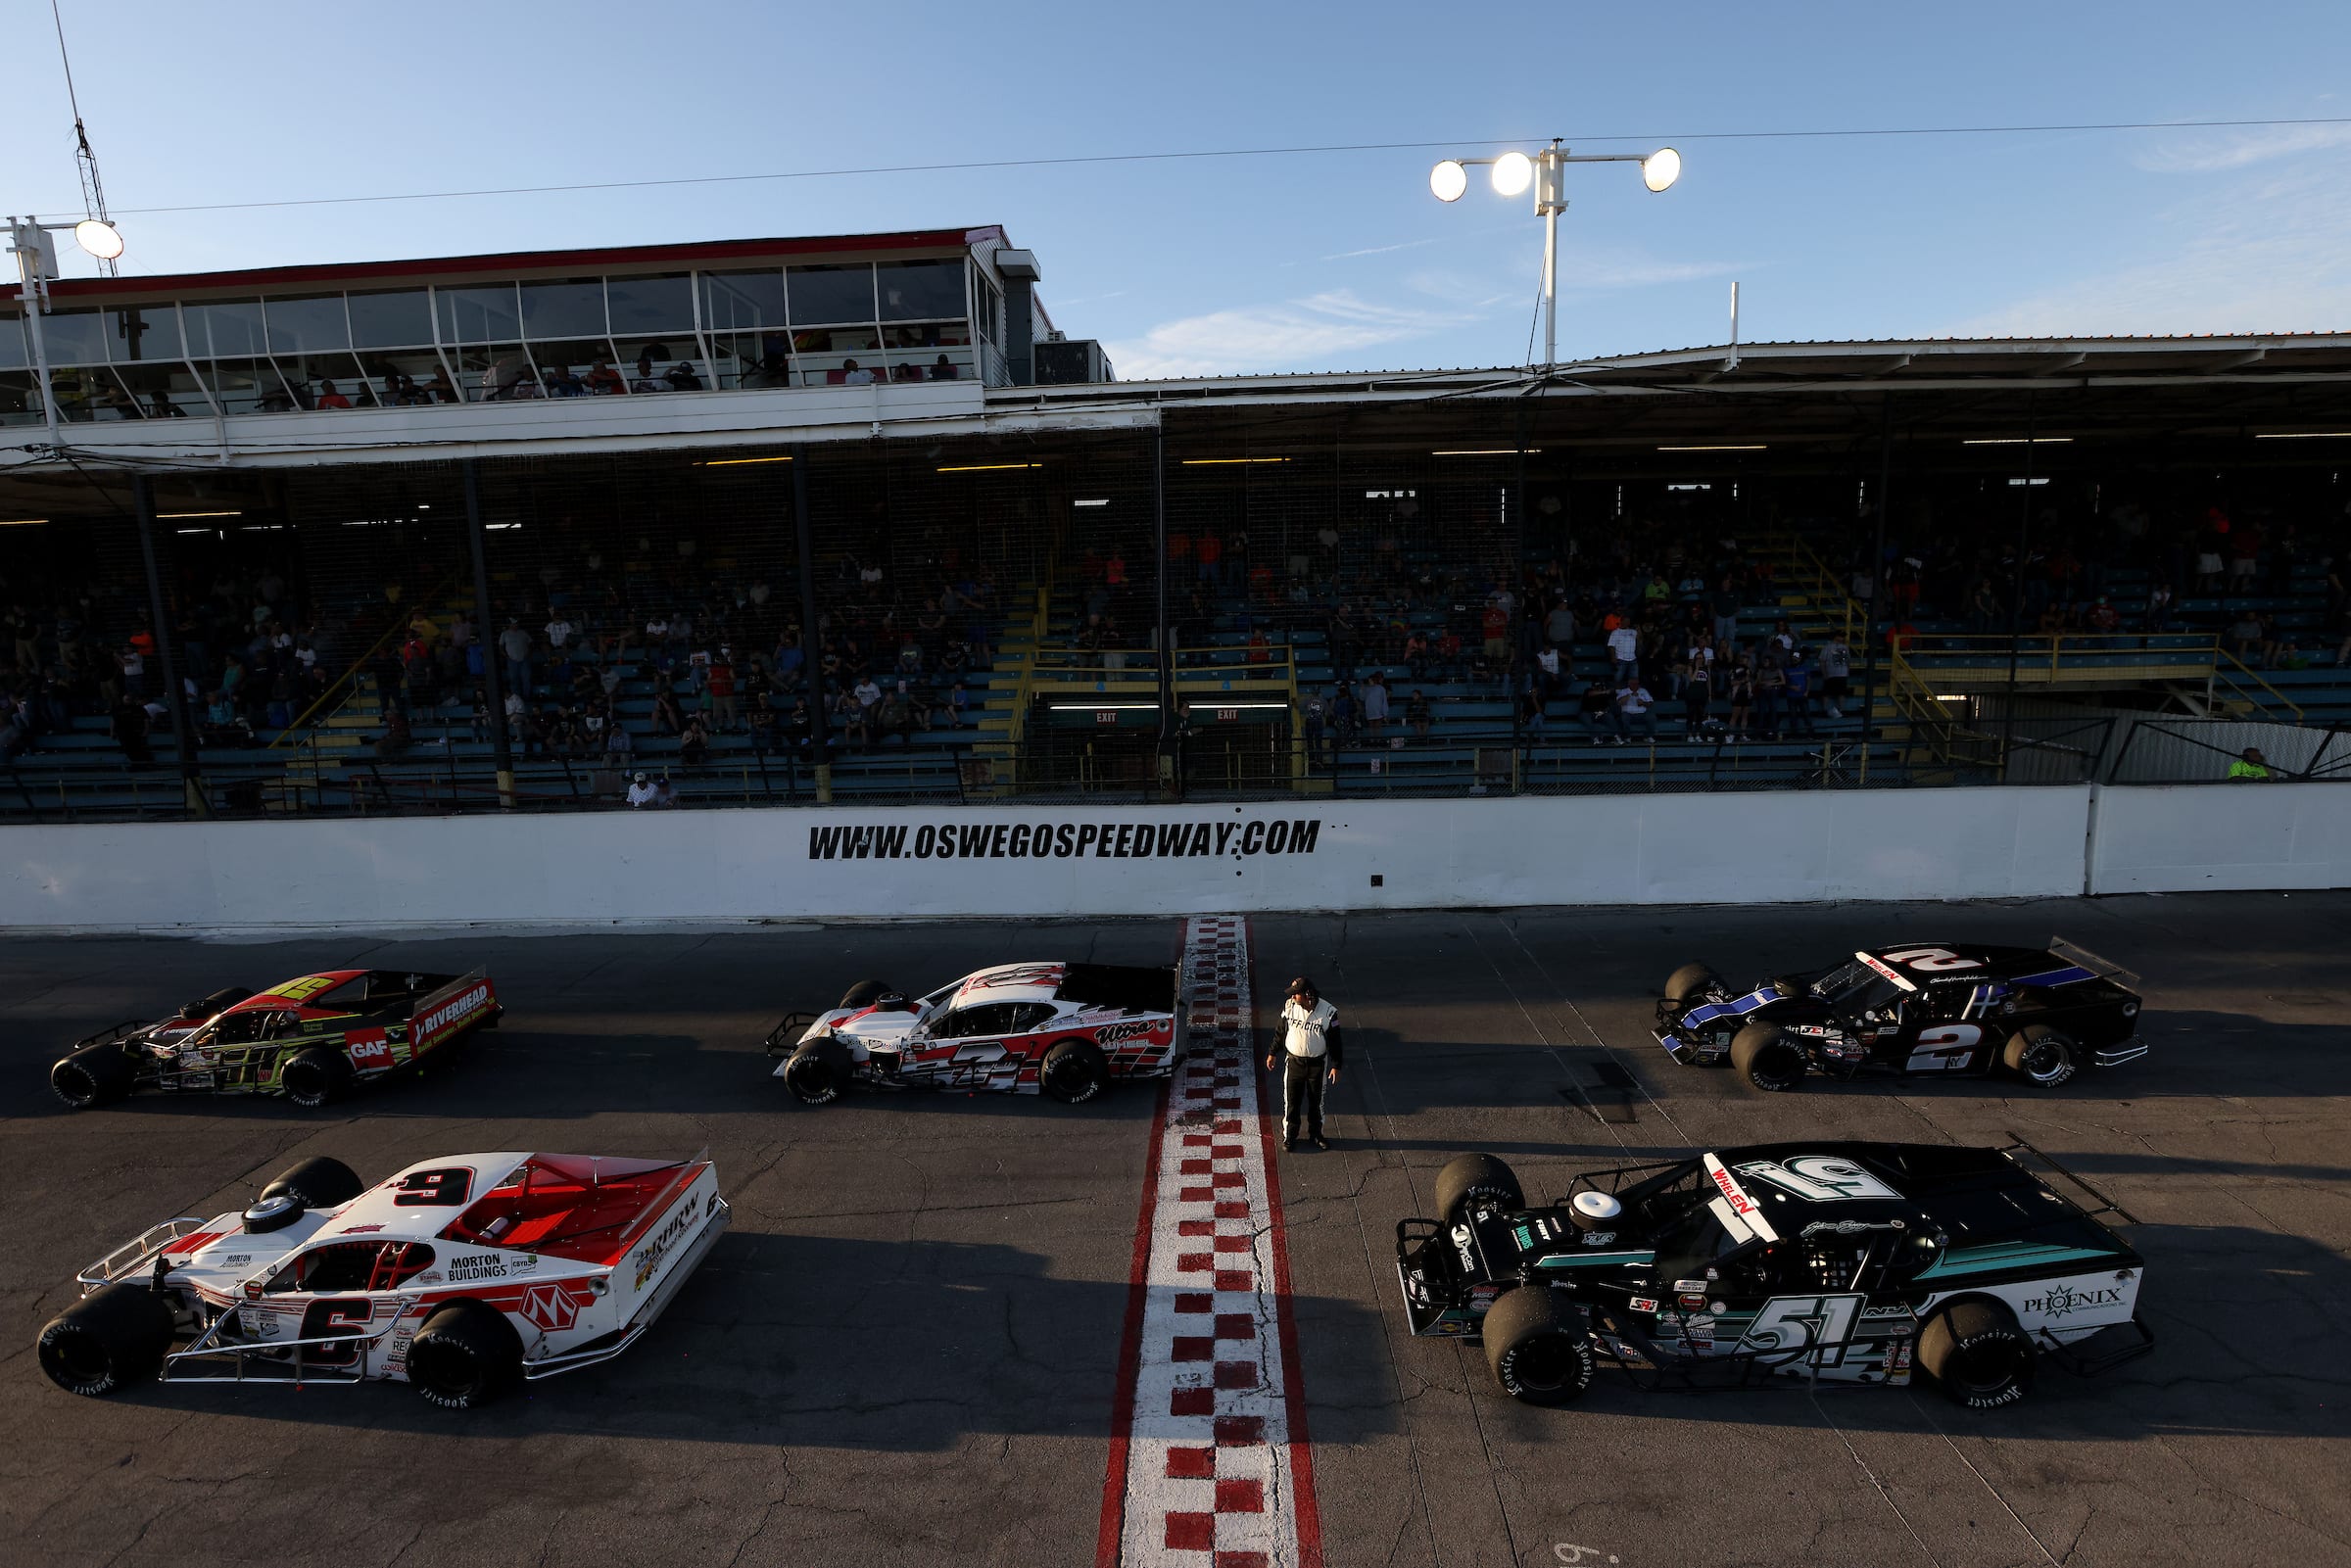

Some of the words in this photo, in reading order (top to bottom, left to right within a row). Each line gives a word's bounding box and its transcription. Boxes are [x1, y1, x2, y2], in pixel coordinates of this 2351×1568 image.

[1096, 712, 1118, 723] EXIT
[1218, 709, 1238, 720] EXIT
[809, 820, 1320, 860] WWW.OSWEGOSPEEDWAY.COM
[1866, 959, 1899, 979] WHELEN
[424, 985, 488, 1034] RIVERHEAD
[1094, 1022, 1155, 1044] Ultra
[350, 1040, 389, 1059] GAF
[1906, 1023, 1984, 1071] 2
[1711, 1168, 1756, 1214] WHELEN
[452, 1254, 501, 1269] MORTON
[448, 1264, 507, 1282] BUILDINGS
[2023, 1287, 2122, 1315] PHOENIX
[1741, 1294, 1867, 1369] 51
